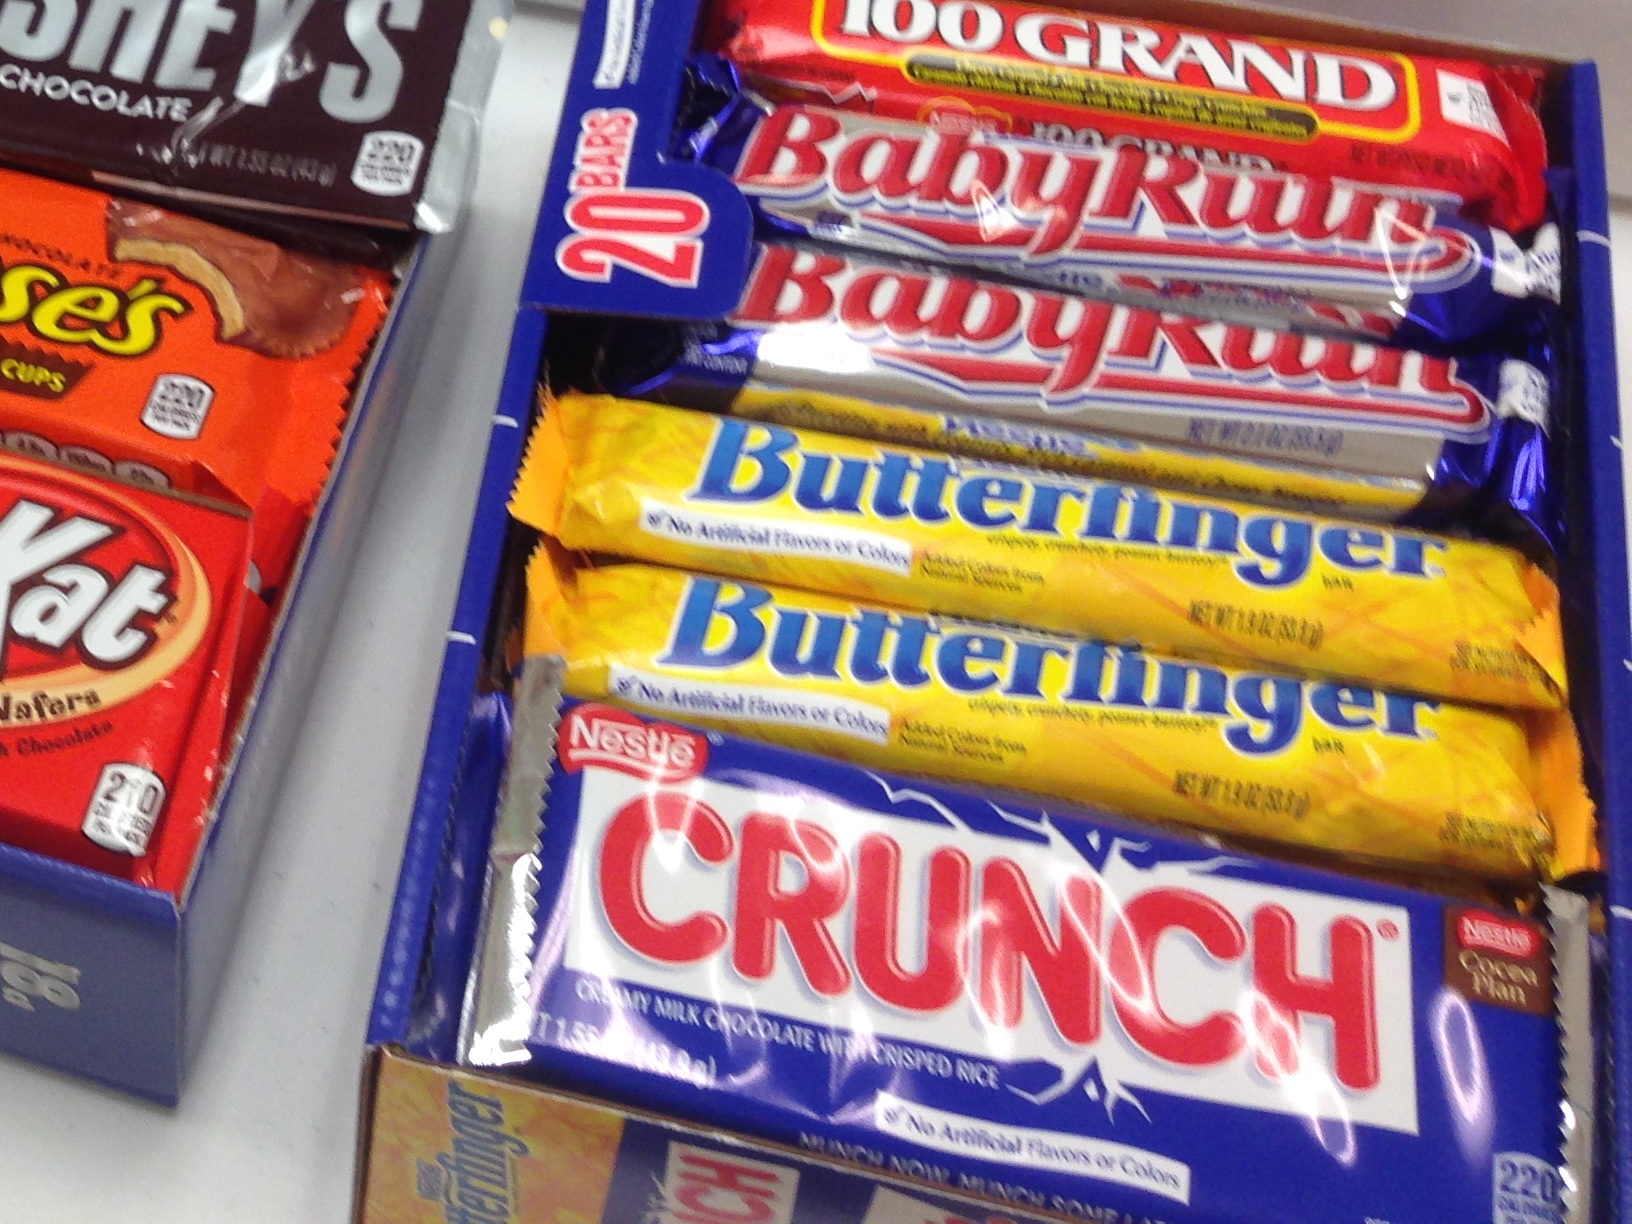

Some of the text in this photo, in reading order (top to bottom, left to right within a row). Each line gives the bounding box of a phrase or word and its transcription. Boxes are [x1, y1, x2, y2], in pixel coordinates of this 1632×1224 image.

[1015, 10, 1398, 113] GRAND
[572, 109, 638, 190] BARS
[557, 190, 709, 286] 20
[1, 358, 67, 395] CUPS
[669, 509, 910, 567] No Artificial Flavors or Colors
[687, 416, 1447, 588] Butterfinger
[639, 675, 889, 736] No Artificial Flavors or Colors
[659, 579, 1441, 758] Butterfinger
[103, 771, 160, 814] 20
[596, 788, 1383, 1091] CRUNCH
[1458, 948, 1538, 988] Cocoa
[1471, 972, 1527, 1007] Plan
[653, 994, 701, 1025] MILK
[703, 1008, 816, 1053] CHOCOLATE
[873, 1040, 953, 1078] CRISPED
[955, 1059, 1000, 1089] RICE
[799, 1130, 884, 1168] MUNCH
[959, 1171, 1046, 1206] MUNCH
[1051, 1193, 1119, 1224] SOME
[906, 1104, 1181, 1191] No Artificial Flavors or Colors
[1499, 1160, 1558, 1203] 220
